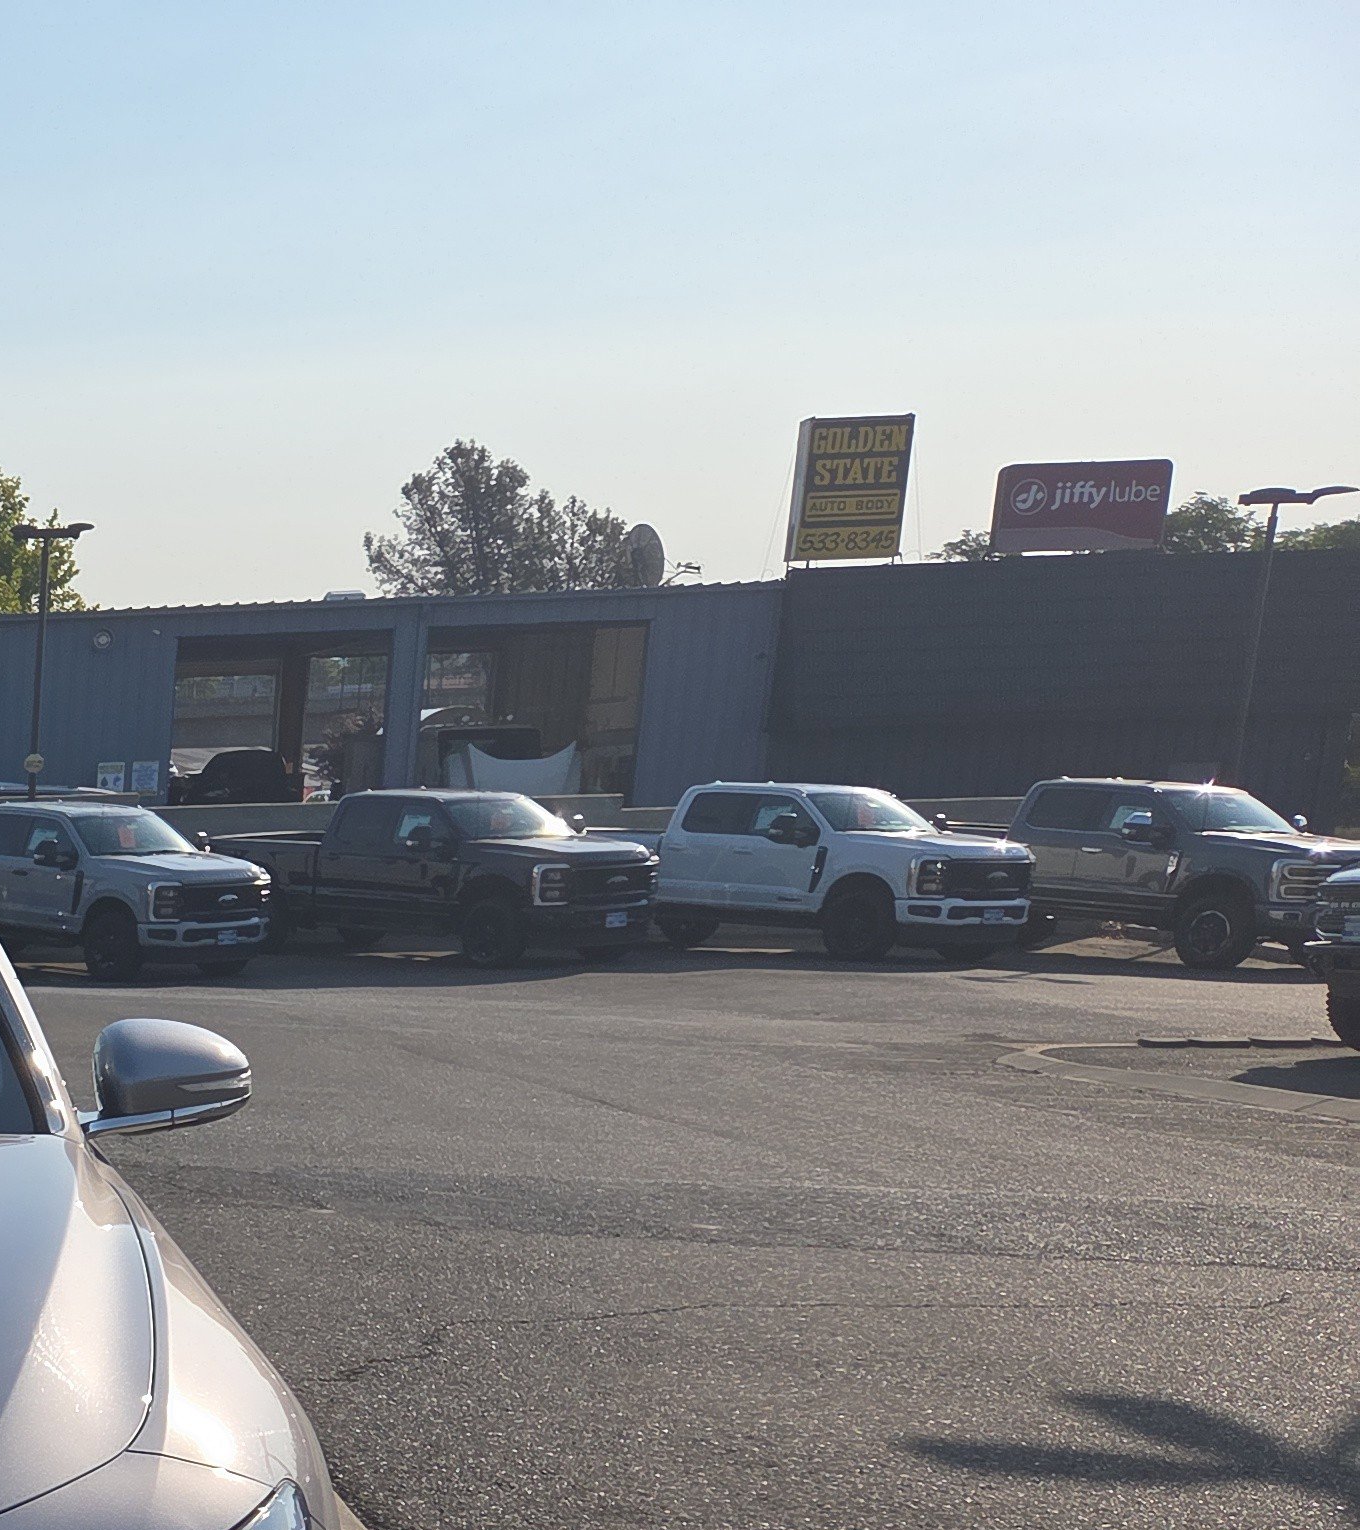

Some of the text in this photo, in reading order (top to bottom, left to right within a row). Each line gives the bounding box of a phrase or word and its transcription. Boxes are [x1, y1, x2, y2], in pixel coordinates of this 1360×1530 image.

[812, 425, 909, 454] GOLDEN
[813, 456, 899, 486] STATE
[809, 498, 895, 513] AUTO BODY
